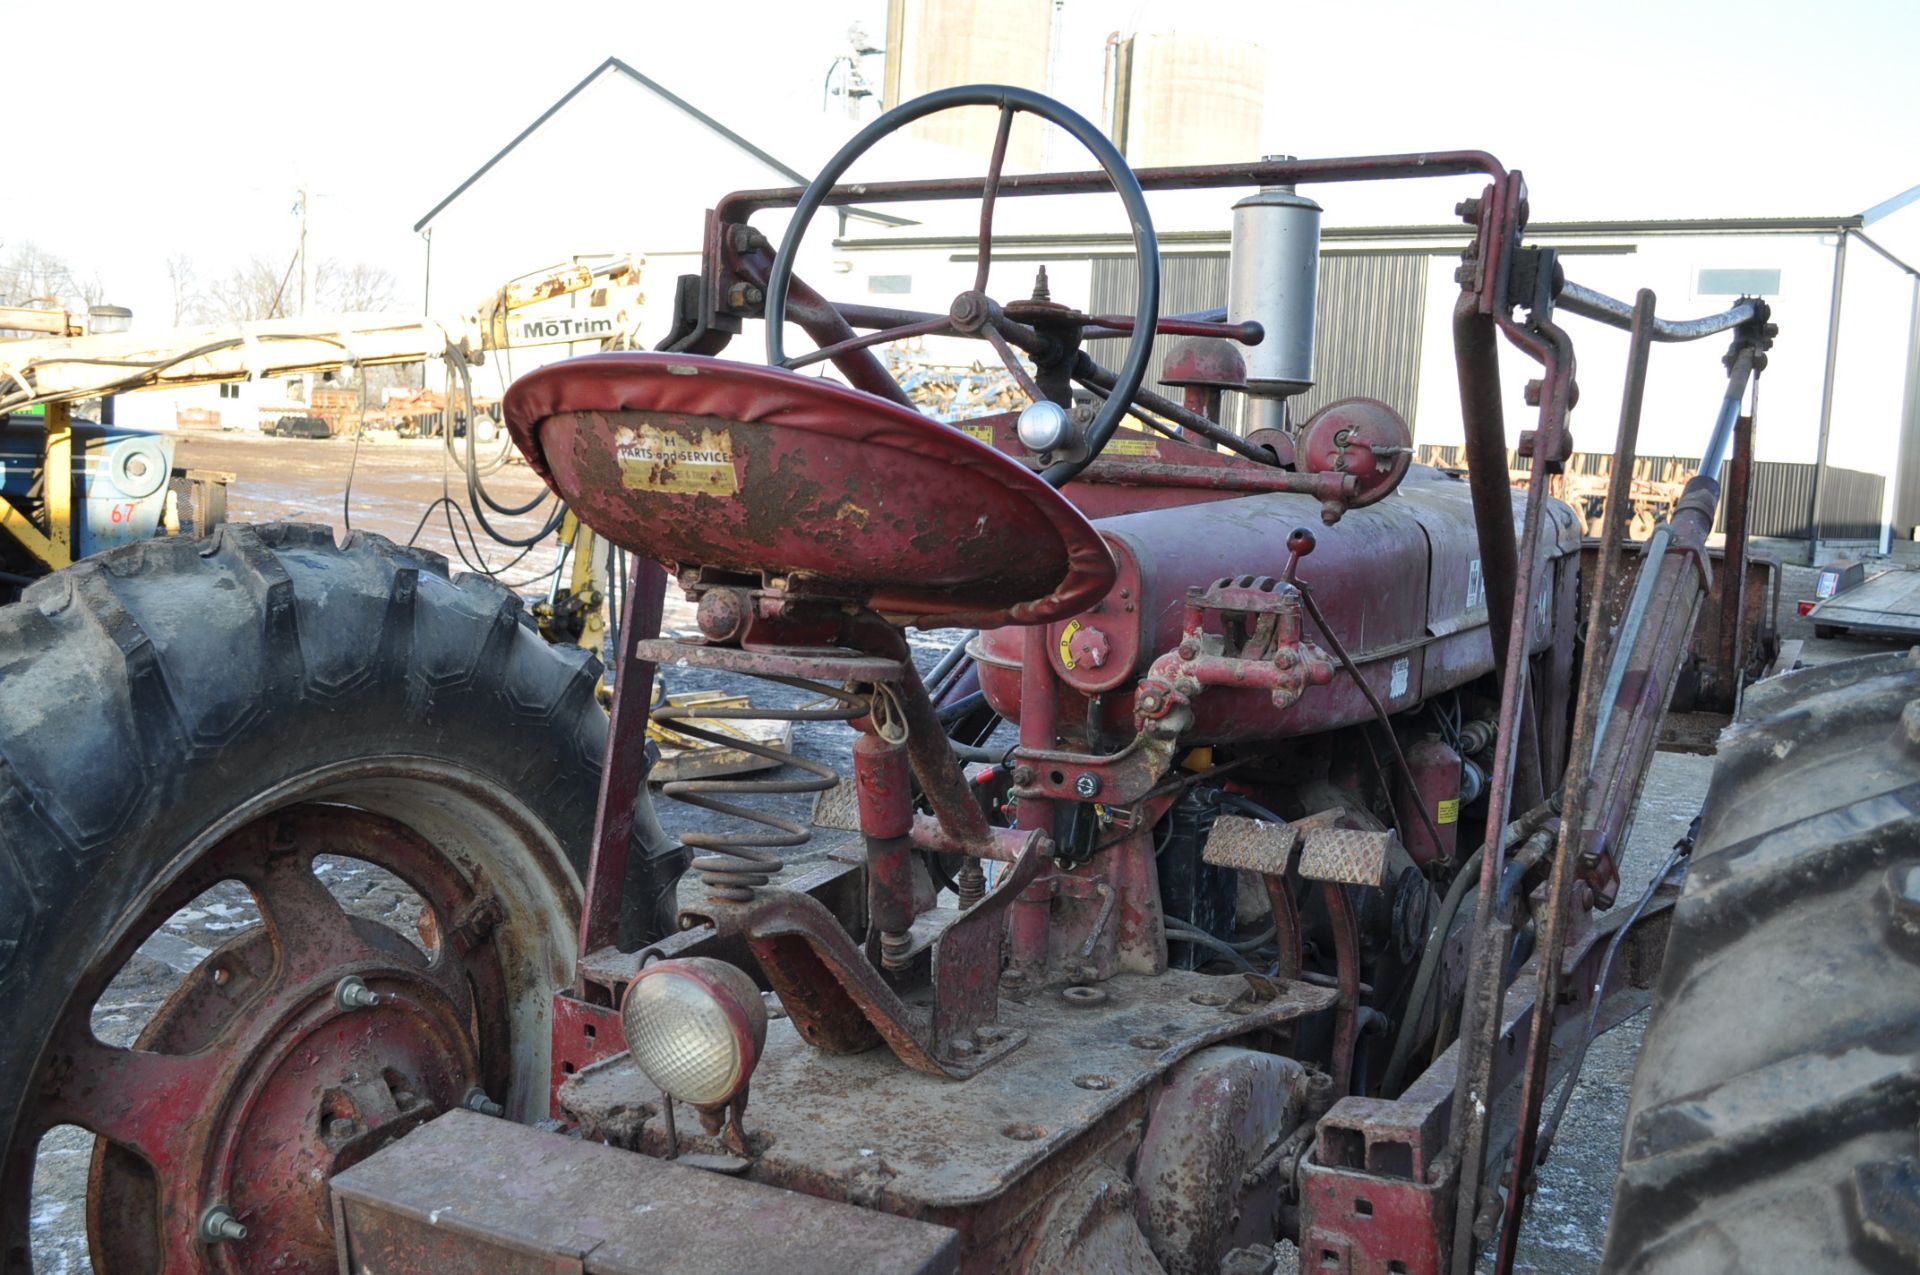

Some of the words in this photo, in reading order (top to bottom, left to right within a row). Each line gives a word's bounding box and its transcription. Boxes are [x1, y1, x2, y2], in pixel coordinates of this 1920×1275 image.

[621, 447, 653, 460] PARTS
[656, 451, 677, 461] and
[680, 452, 730, 463] SERVICE
[111, 503, 135, 524] 67
